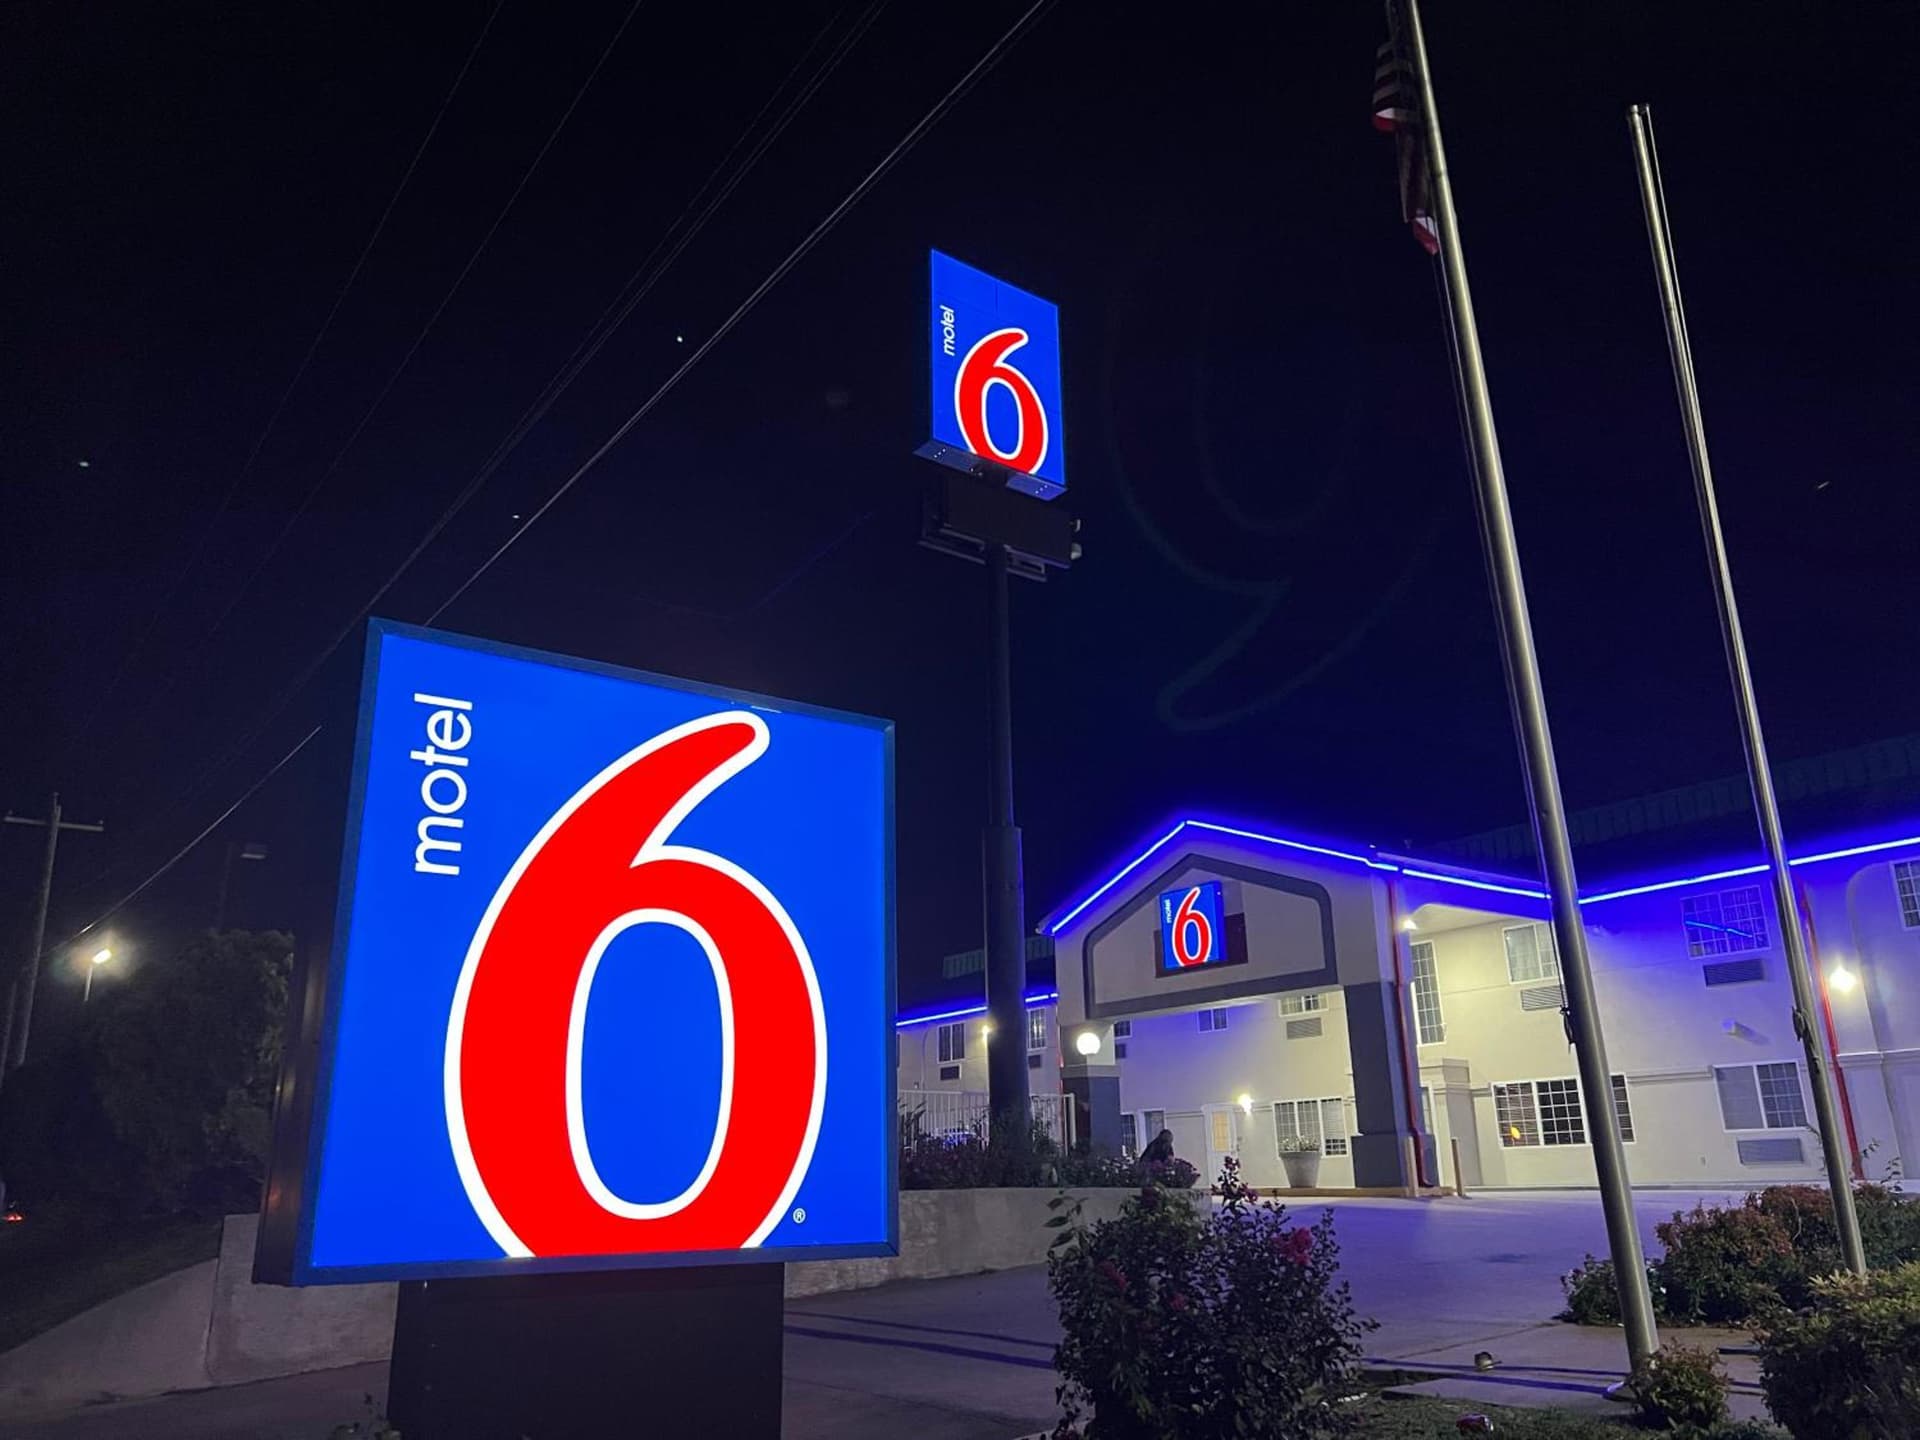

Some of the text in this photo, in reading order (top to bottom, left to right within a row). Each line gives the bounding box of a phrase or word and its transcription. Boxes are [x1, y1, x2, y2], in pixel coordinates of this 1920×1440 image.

[940, 304, 955, 356] motel
[954, 327, 1049, 475] 6
[410, 693, 473, 876] motel
[444, 710, 828, 1258] 6
[1172, 887, 1212, 966] 6
